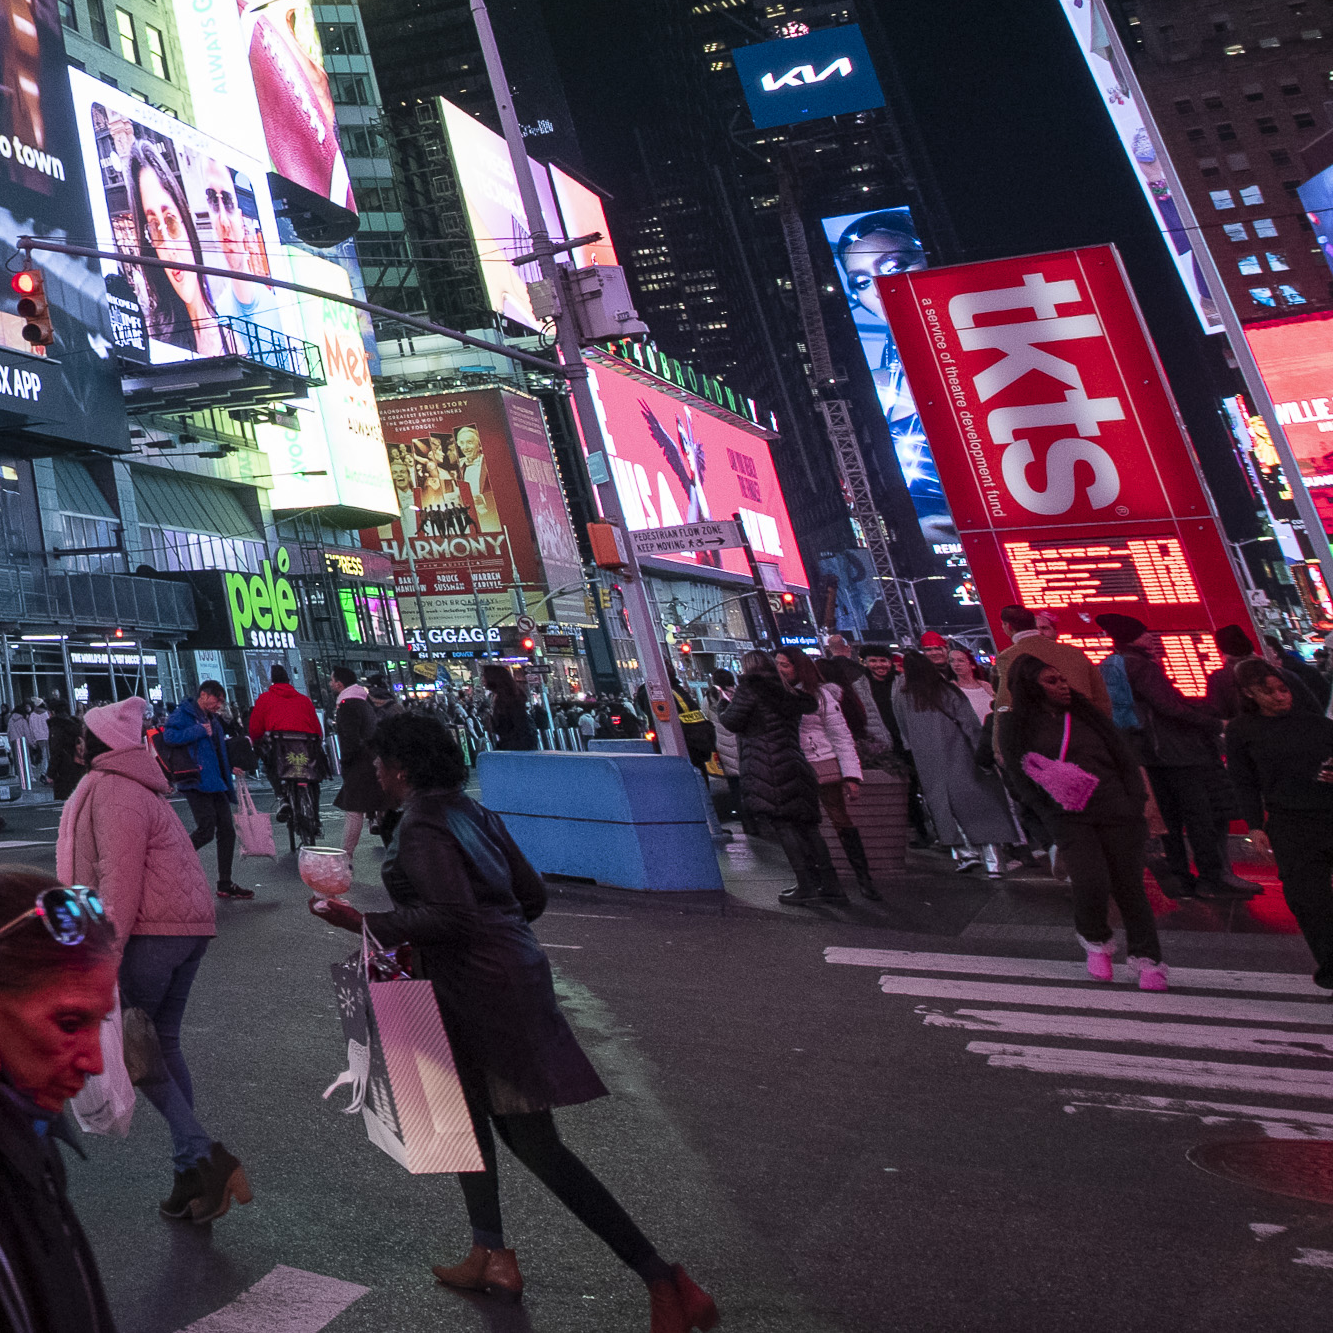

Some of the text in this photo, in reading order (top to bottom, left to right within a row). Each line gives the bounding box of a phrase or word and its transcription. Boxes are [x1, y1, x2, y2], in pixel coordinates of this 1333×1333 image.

[13, 136, 66, 181] town
[14, 369, 42, 401] APP
[948, 273, 1126, 516] tkts
[419, 403, 440, 411] TRUE
[442, 400, 468, 408] STORY
[921, 298, 1007, 518] a service of theatre development fund
[388, 409, 462, 420] GREATEST ENTERTAINERS
[633, 525, 722, 541] PEDESTRIAN FLOW ZONE
[381, 535, 505, 561] HARMONY
[636, 540, 685, 552] KEEP MOVING
[436, 574, 459, 583] BRUCE
[472, 572, 501, 581] WARREN
[434, 582, 465, 592] SUSSMAN
[225, 546, 298, 646] pelé
[251, 630, 296, 648] SOCCER
